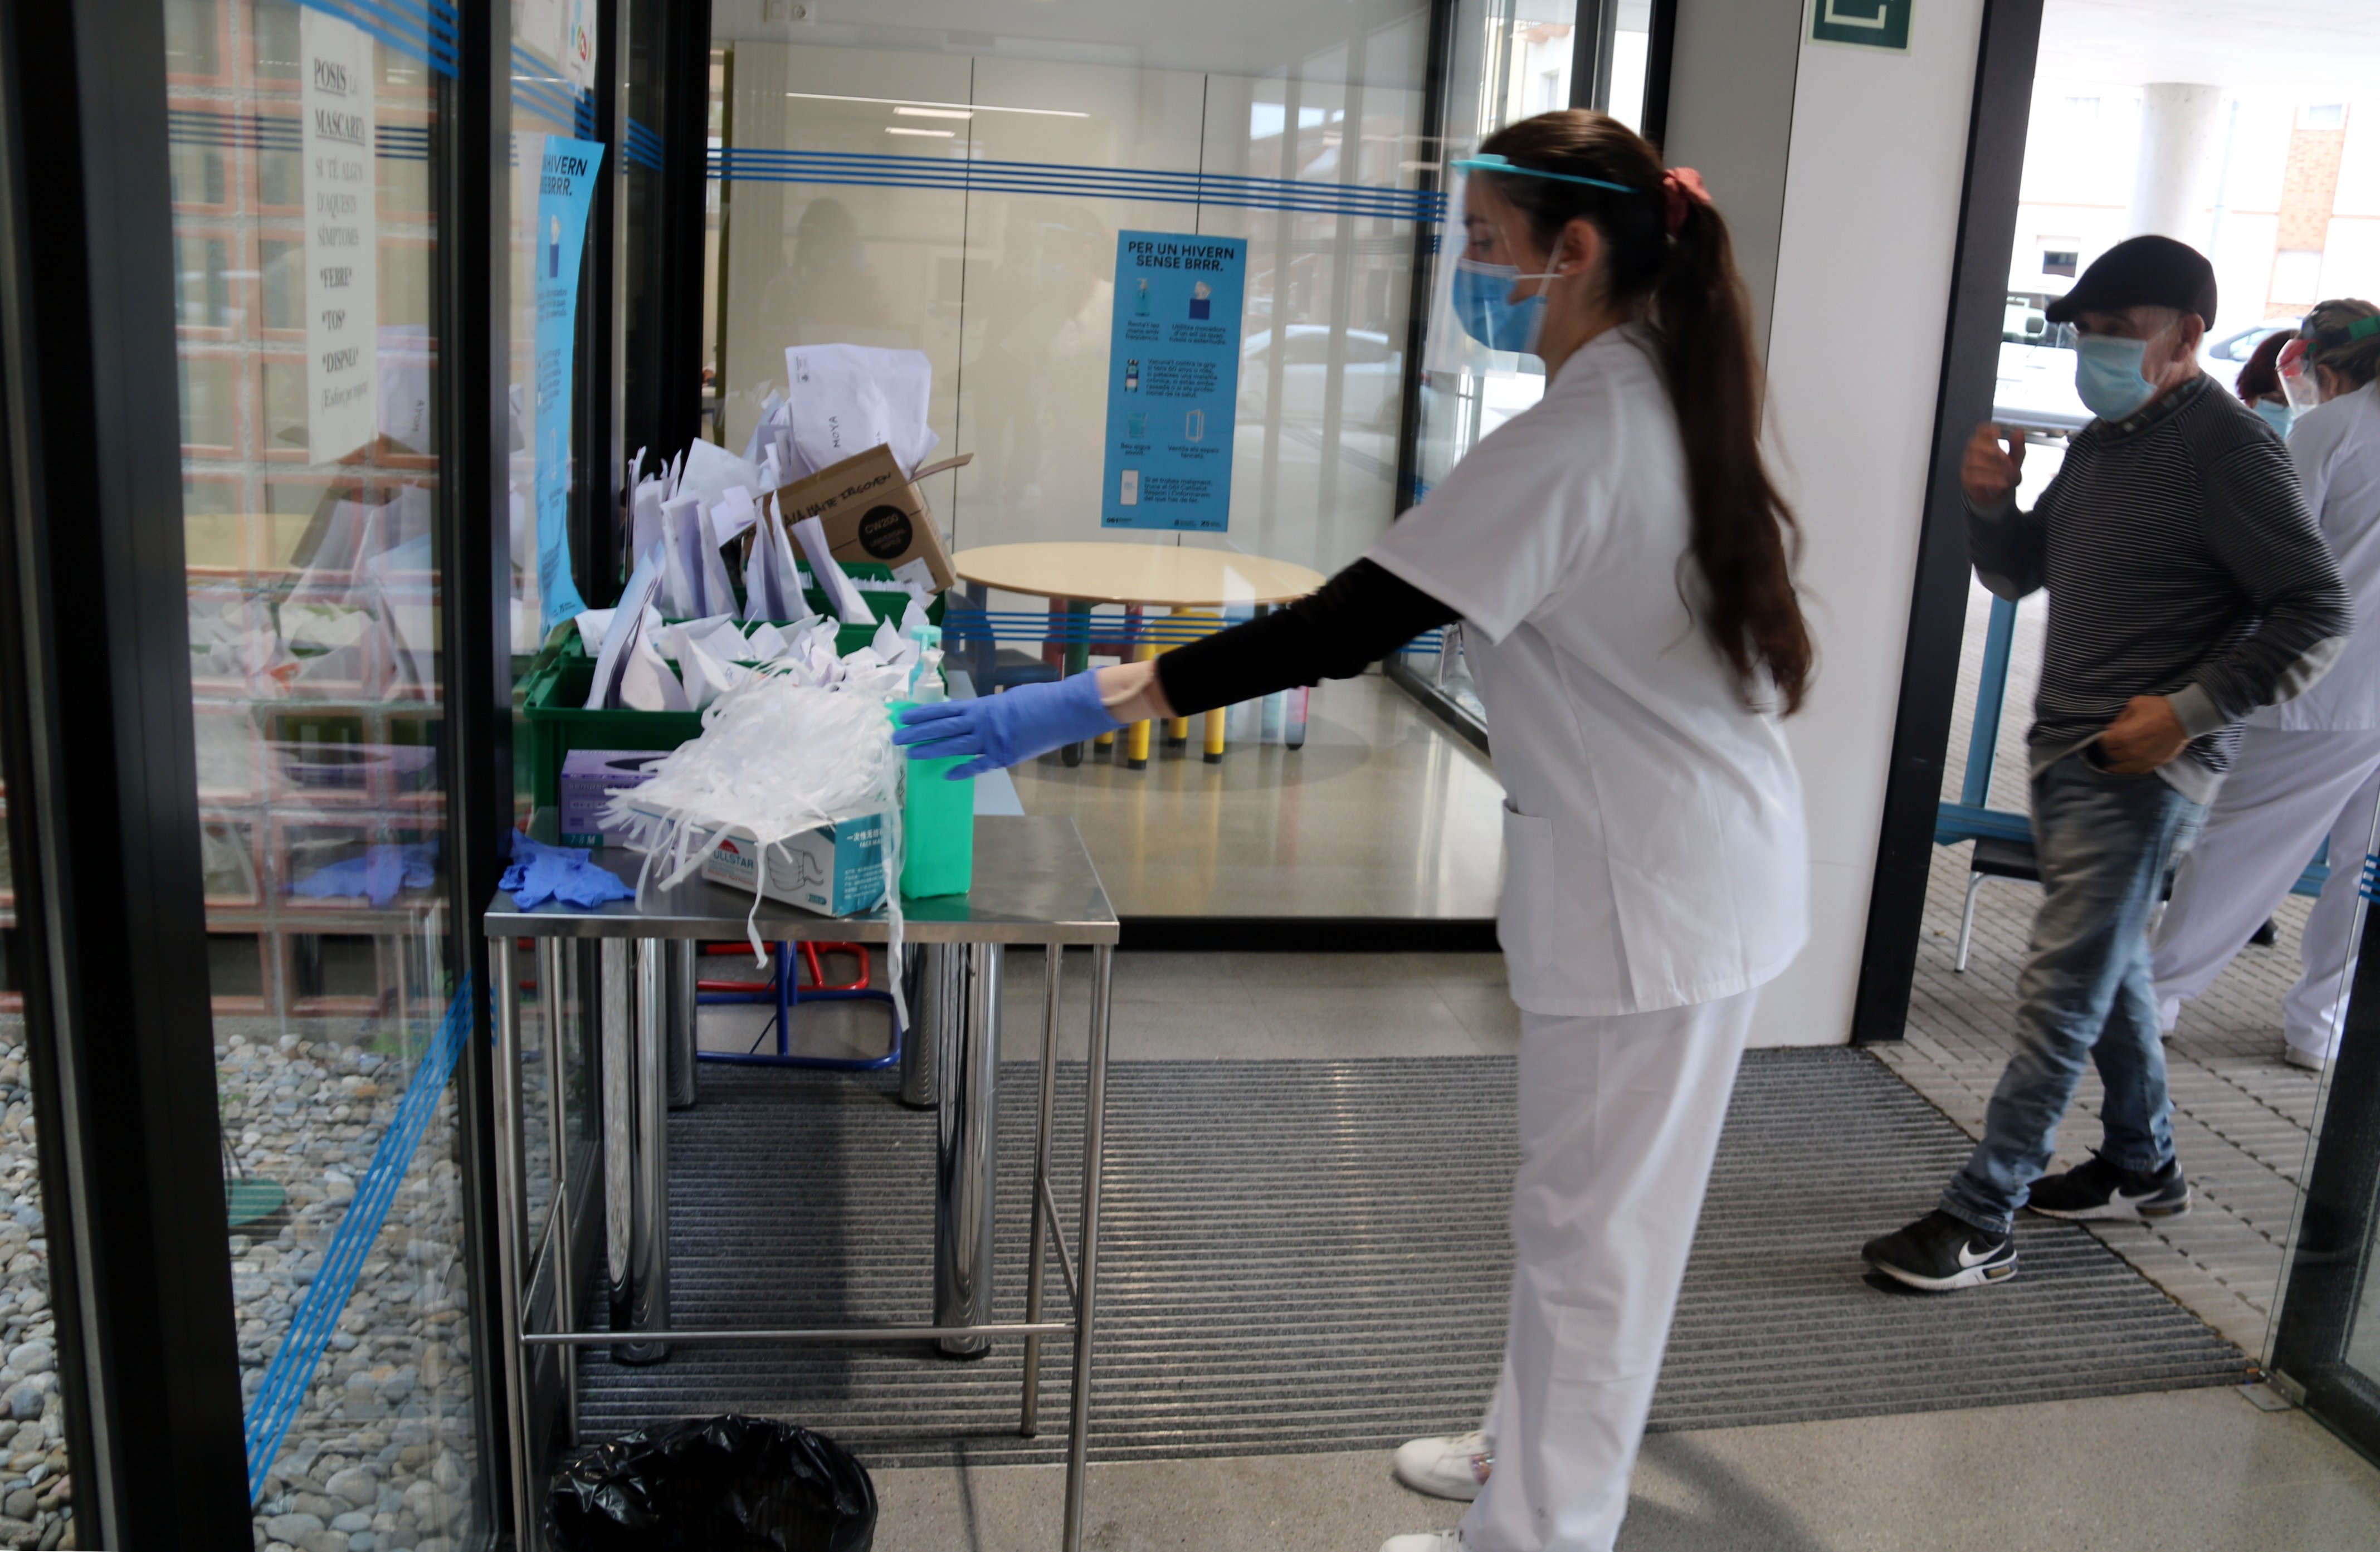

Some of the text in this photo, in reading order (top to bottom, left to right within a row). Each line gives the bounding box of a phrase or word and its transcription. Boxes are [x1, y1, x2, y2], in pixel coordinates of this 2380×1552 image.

[314, 57, 346, 92] POSIS
[1129, 241, 1235, 260] PER UN HIVERN
[1137, 255, 1224, 272] SENSE BRRR.
[713, 850, 754, 870] ULLSTAR
